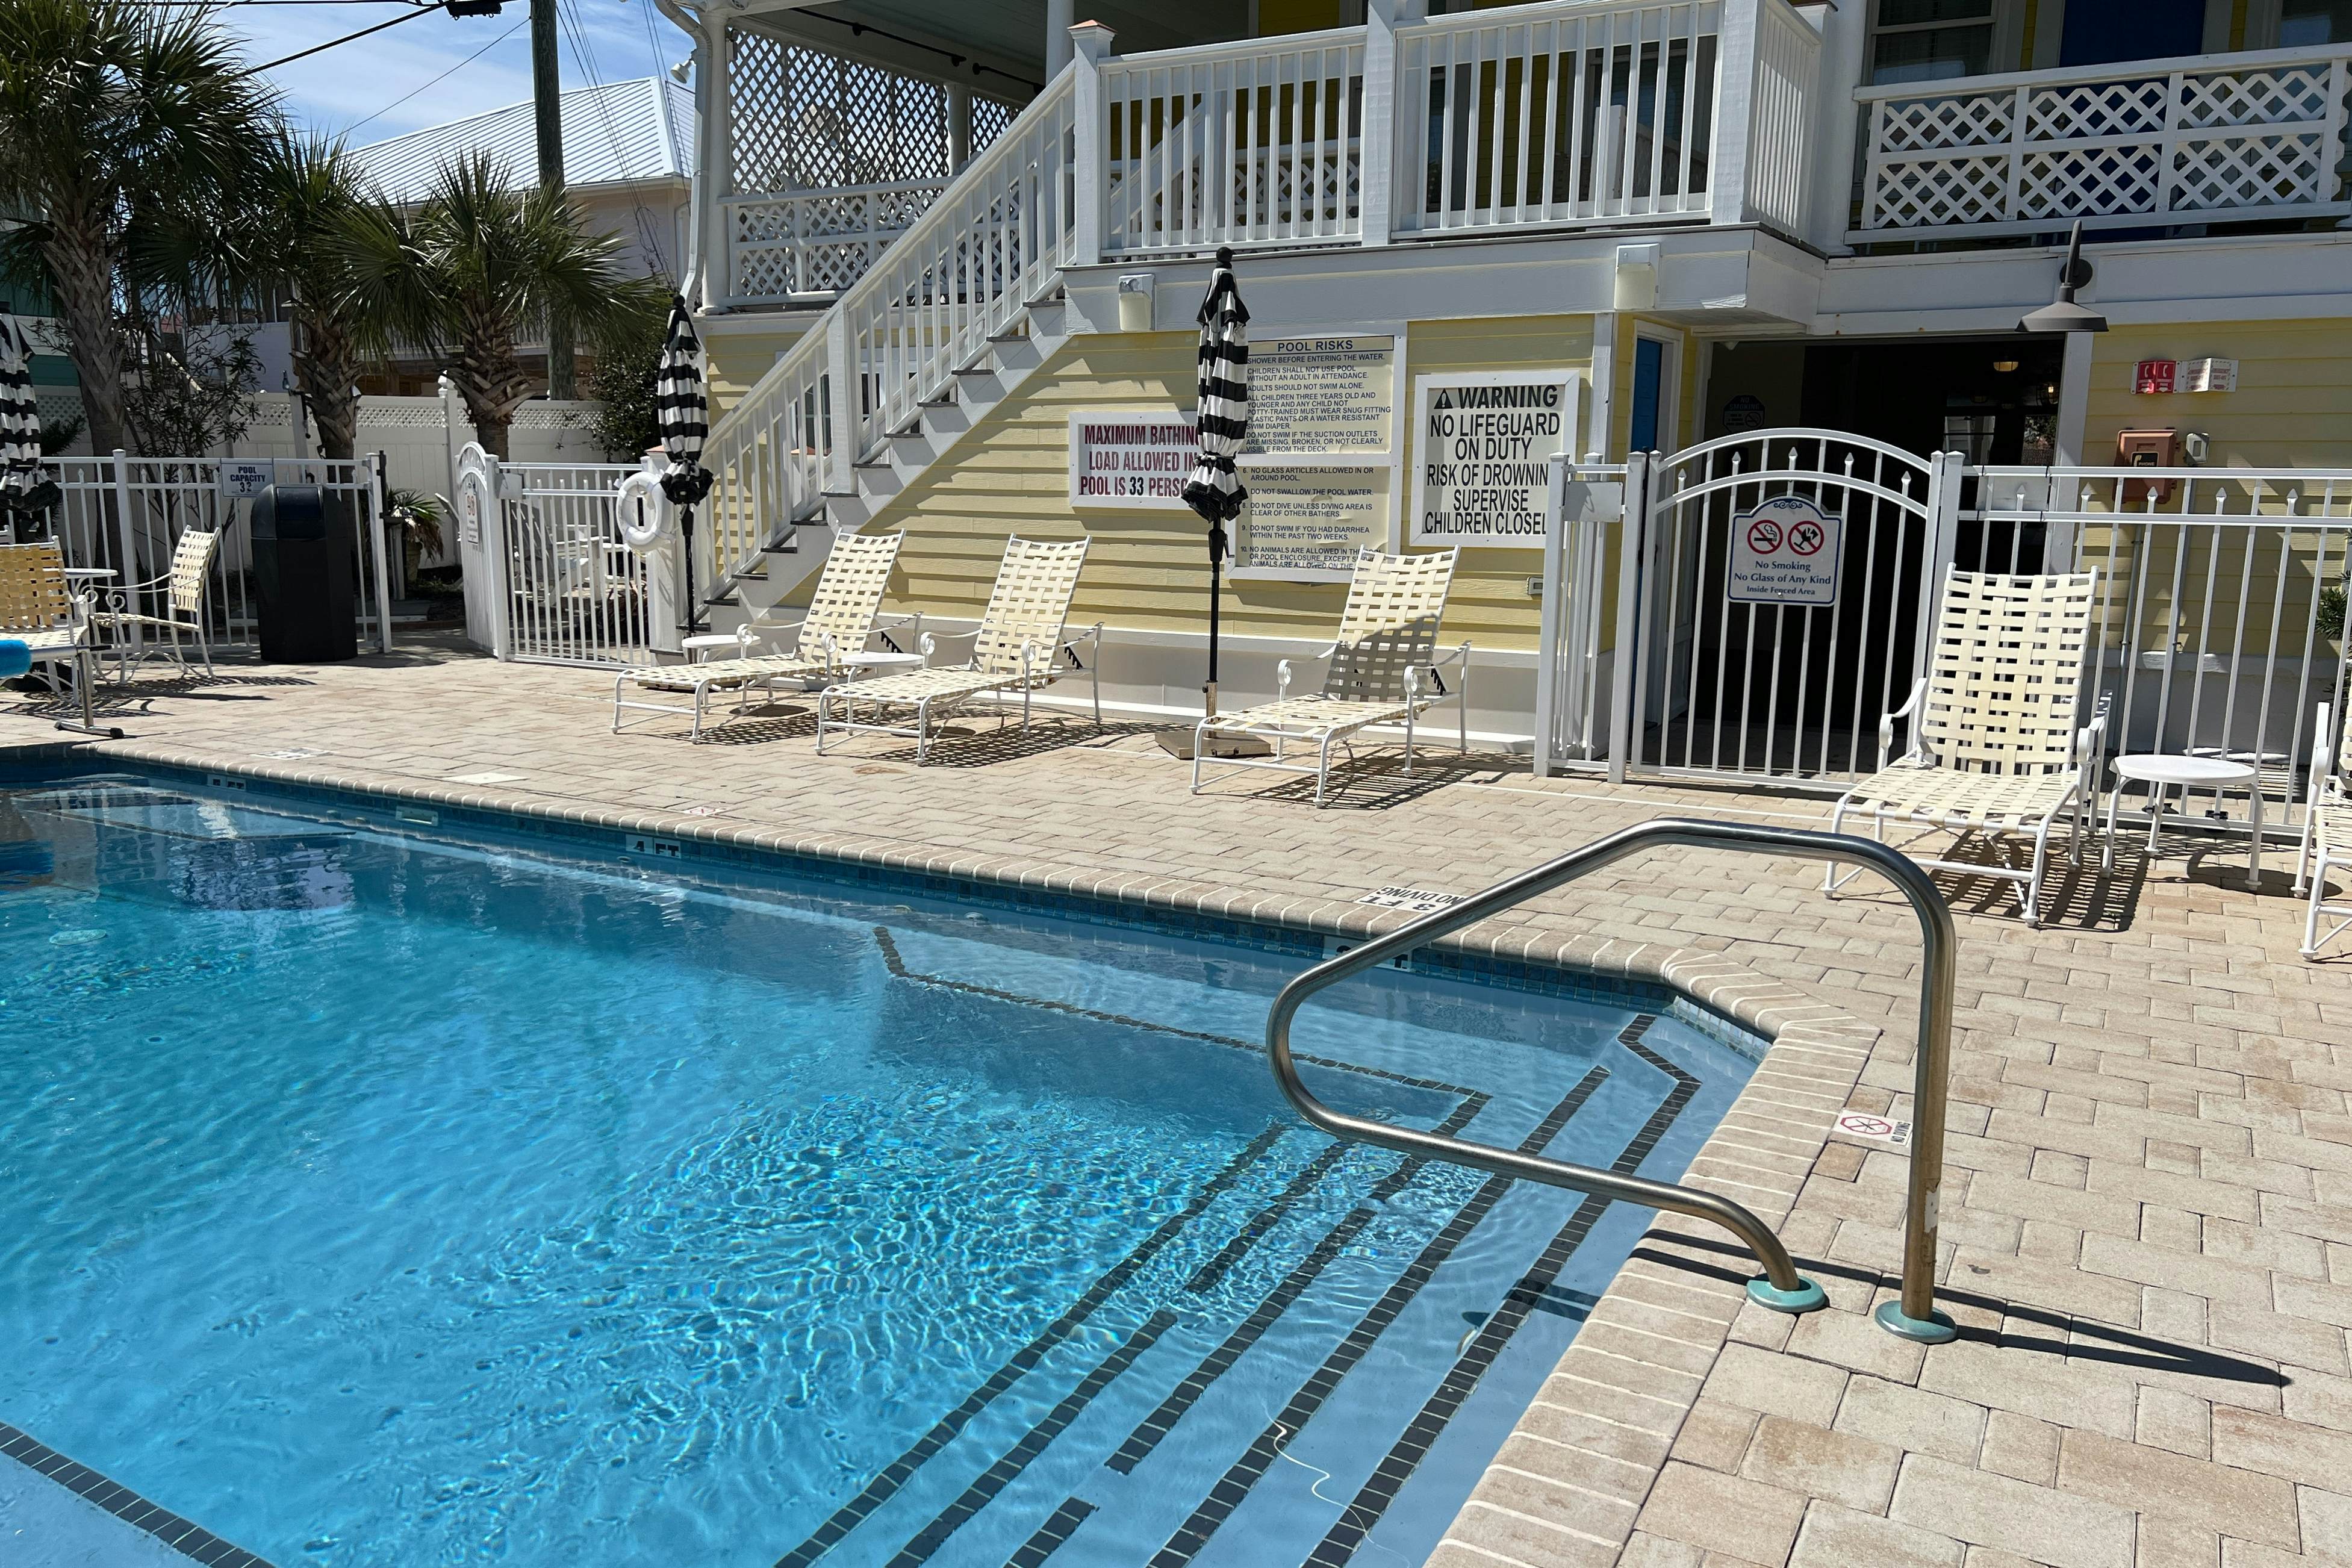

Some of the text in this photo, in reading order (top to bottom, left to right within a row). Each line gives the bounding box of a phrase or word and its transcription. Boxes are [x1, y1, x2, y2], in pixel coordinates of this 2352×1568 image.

[1278, 340, 1352, 352] POOL RISKS
[1458, 385, 1558, 409] WARNING
[1431, 412, 1560, 437] NO LIFEGUARD
[1085, 425, 1146, 445] MAXIMUM
[1455, 437, 1532, 460] ON DUTY
[1089, 451, 1197, 471] LOAD ALLOWED IN
[1427, 463, 1549, 486] RISK OF DROWNIN
[1080, 476, 1110, 495] POOL
[1114, 477, 1125, 496] IS
[1130, 477, 1144, 496] 33
[1454, 489, 1529, 511] SUPERVISE
[1425, 512, 1546, 534] CHILDREN CLOSEL
[1772, 561, 1811, 572] Smoking
[1751, 574, 1775, 582] Glass
[1788, 575, 1807, 585] Any
[1809, 576, 1831, 584] Kind
[633, 841, 645, 852] 4
[1377, 887, 1439, 901] DIVING
